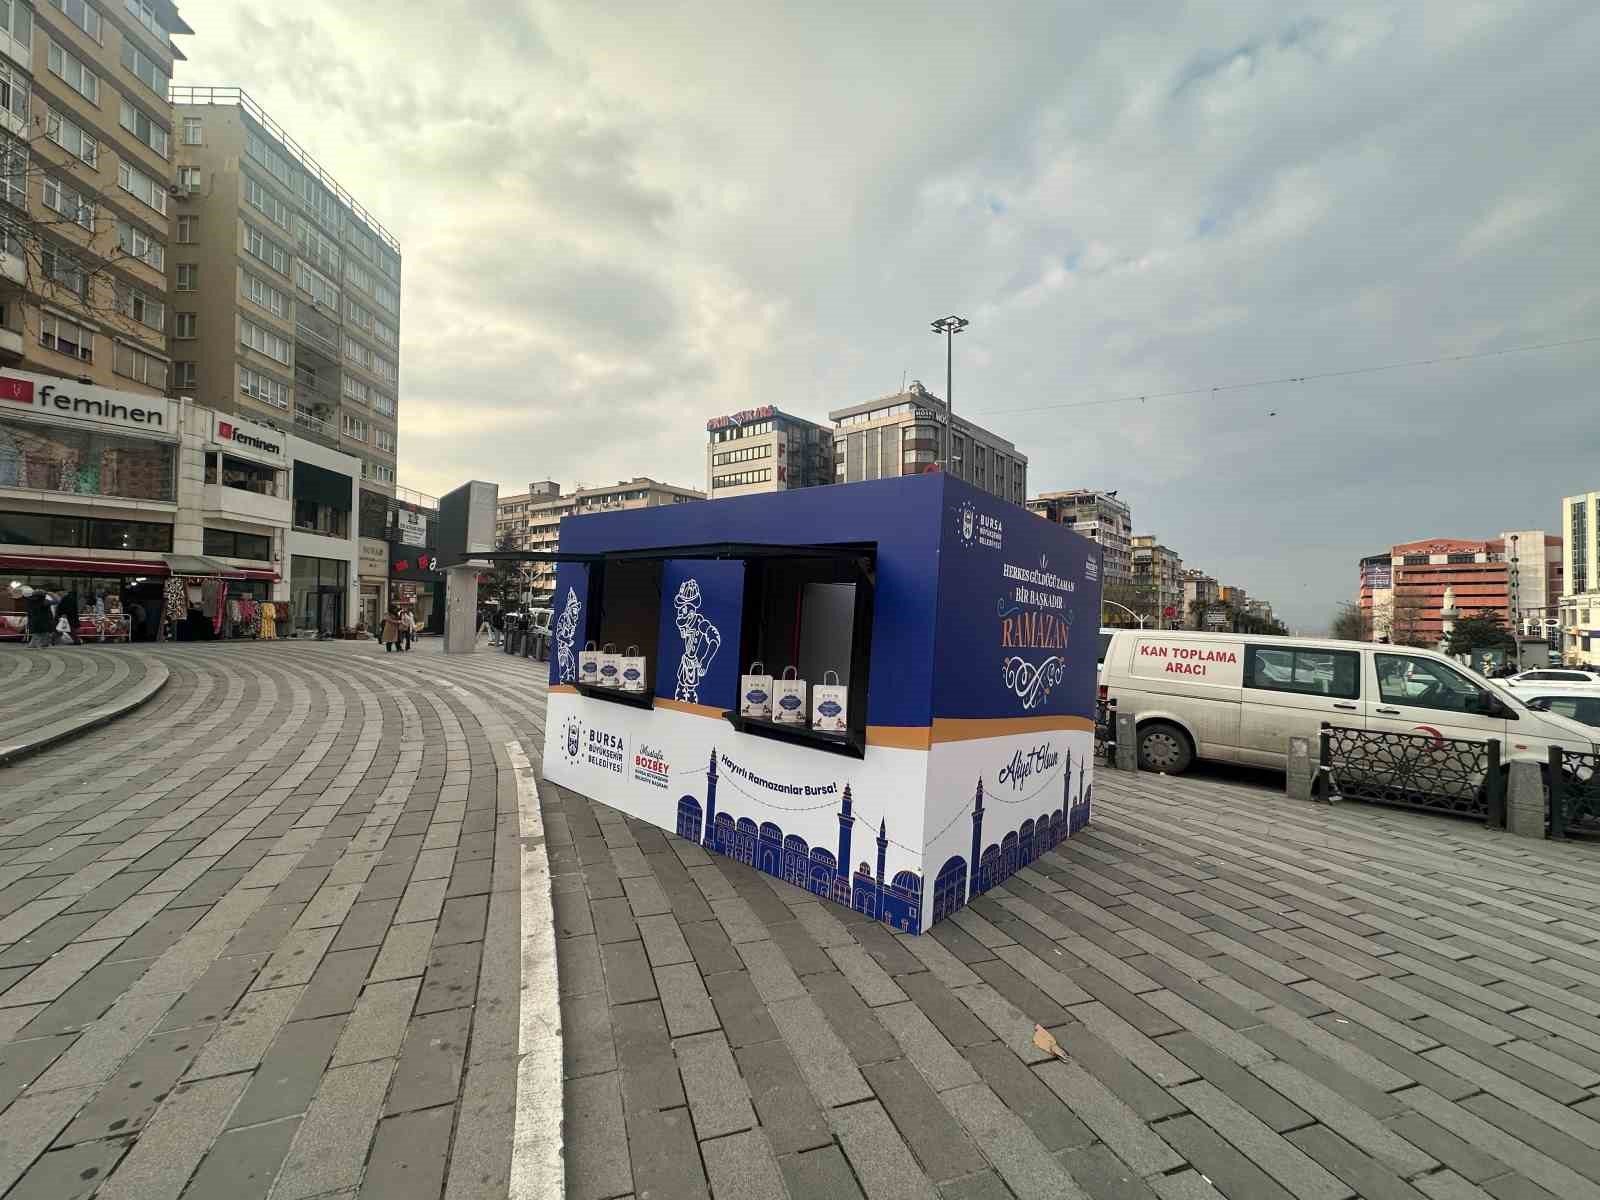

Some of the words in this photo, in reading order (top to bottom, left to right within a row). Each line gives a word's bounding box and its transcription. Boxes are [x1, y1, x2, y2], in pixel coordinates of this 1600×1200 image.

[38, 385, 163, 426] feminen
[231, 427, 280, 455] feminen
[980, 513, 1002, 532] BURSA
[1003, 563, 1030, 582] HERKES
[1056, 578, 1075, 592] ZAMAN
[1016, 585, 1029, 604] BİR
[1030, 590, 1063, 610] BAŞKADIR
[1002, 611, 1070, 648] RAMAZAN
[1140, 645, 1168, 657] KAN
[1172, 648, 1237, 664] TOPLAMA
[1166, 662, 1206, 675] ARACI
[589, 728, 624, 750] BURSA
[588, 754, 623, 773] BELEDİYESİ
[635, 755, 670, 774] BOZBEY
[721, 754, 748, 779] Hayırlı
[748, 771, 803, 796] Ramazanlar
[804, 781, 838, 796] Bursa!
[999, 747, 1037, 791] Afiyet
[1036, 741, 1058, 773] Olsun
